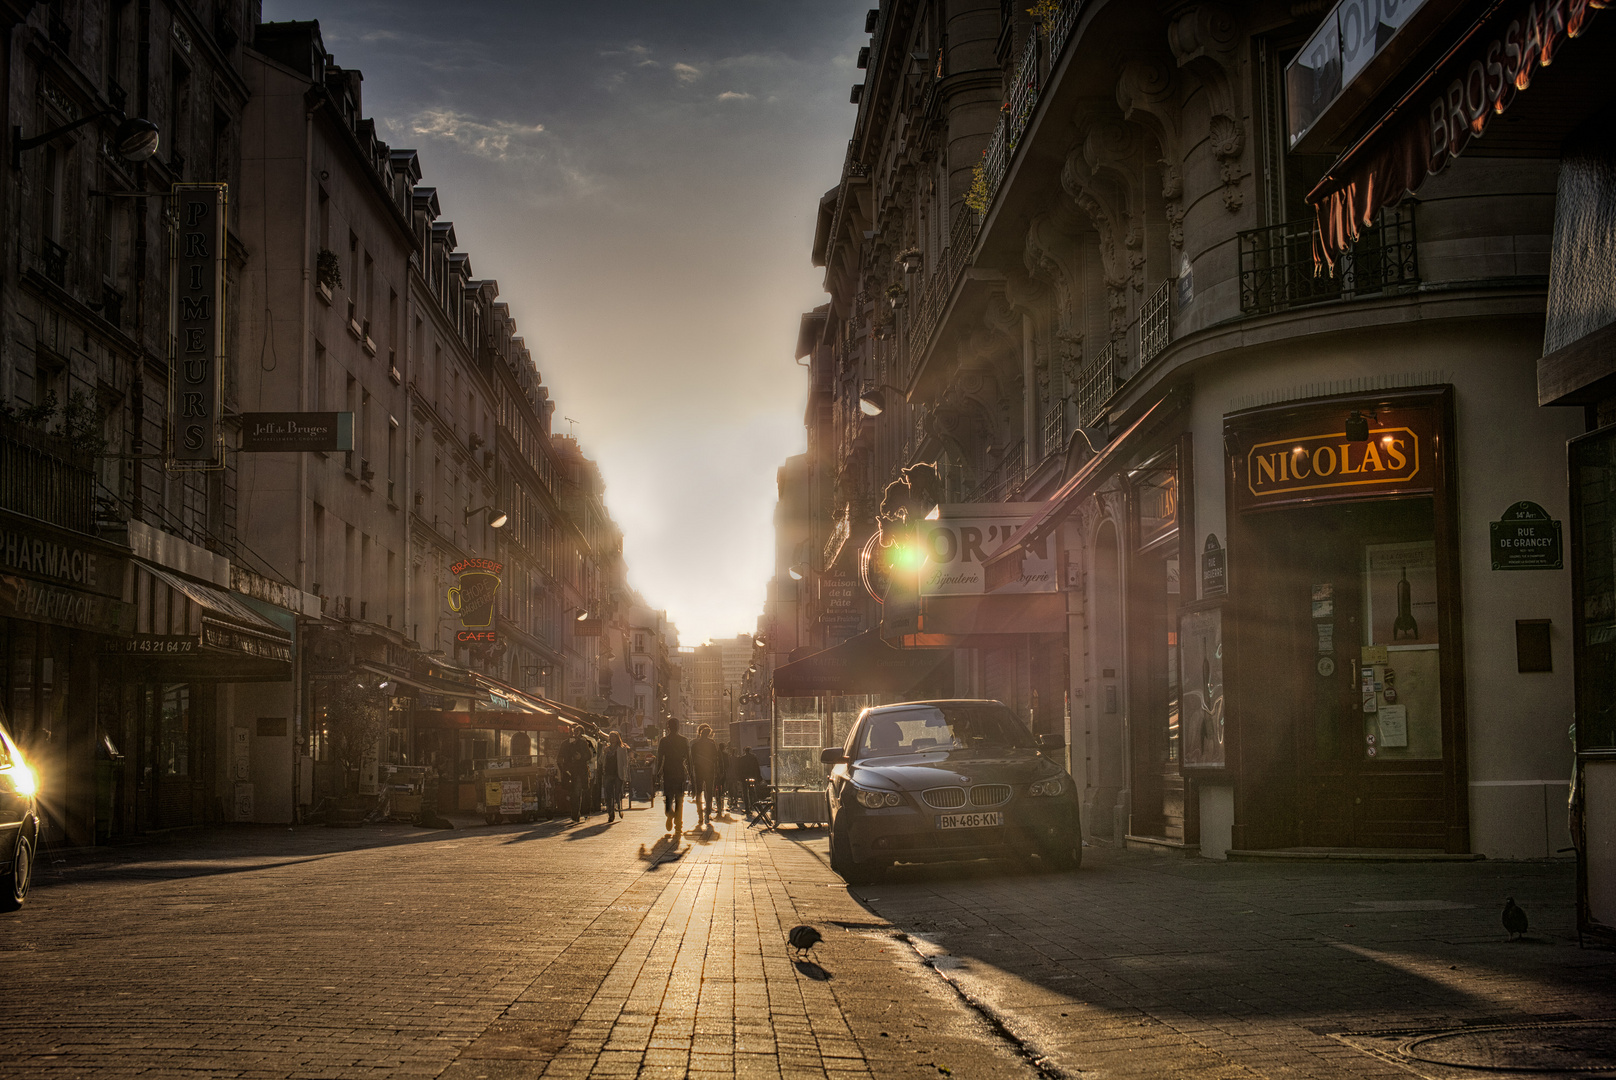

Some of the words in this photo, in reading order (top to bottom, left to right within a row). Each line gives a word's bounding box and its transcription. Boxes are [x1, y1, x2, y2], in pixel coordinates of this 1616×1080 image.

[181, 201, 210, 450] PRIMEURS
[253, 423, 275, 436] Jeff
[276, 426, 285, 434] de
[287, 421, 328, 436] Bruges
[1256, 439, 1407, 485] NICOLAS
[1517, 527, 1535, 536] RUE
[1500, 538, 1512, 548] DE
[1513, 537, 1552, 547] GRANCEY
[451, 558, 503, 575] BRASSERIE
[823, 579, 857, 587] Maison
[460, 578, 491, 603] CHOPE
[829, 589, 840, 597] de
[842, 589, 852, 597] la
[830, 599, 851, 607] Pâte
[457, 631, 495, 642] CAFE
[126, 640, 137, 652] 01
[139, 641, 151, 652] 43
[153, 642, 164, 652] 21
[166, 642, 178, 653] 64
[180, 642, 192, 652] 70
[942, 813, 997, 828] BN-486-KN
